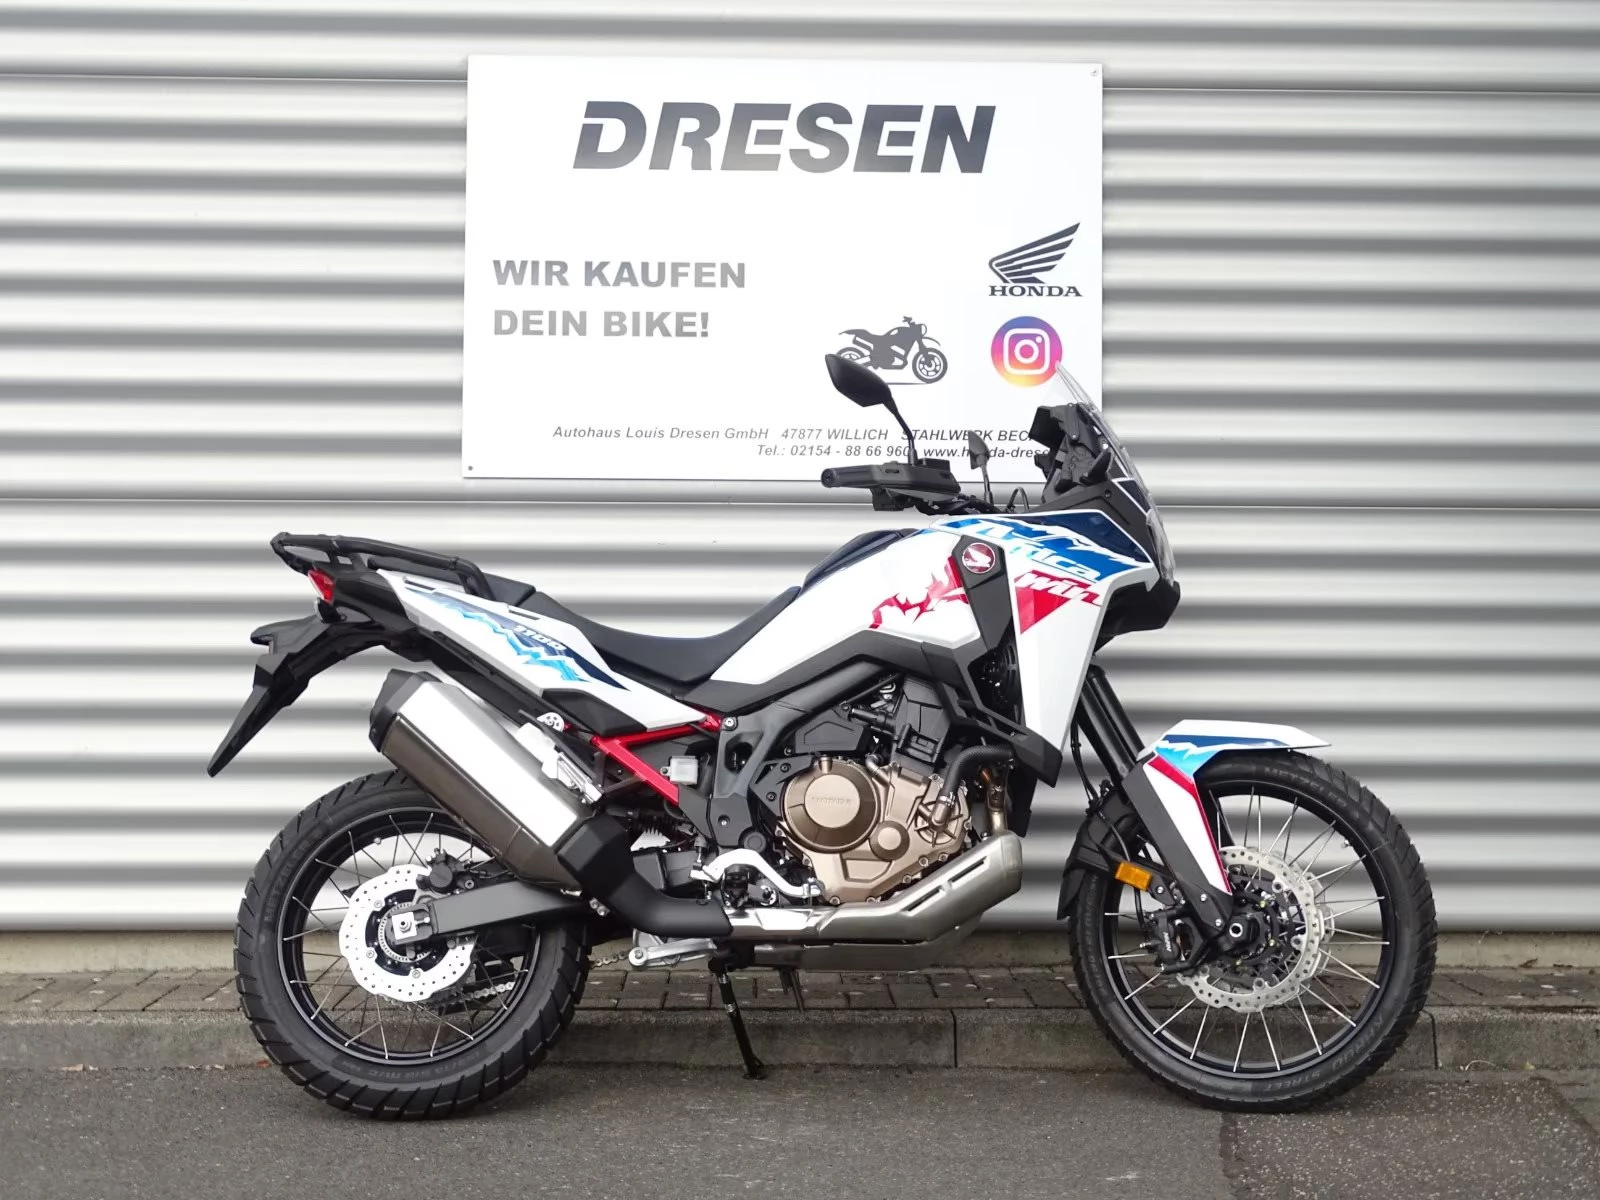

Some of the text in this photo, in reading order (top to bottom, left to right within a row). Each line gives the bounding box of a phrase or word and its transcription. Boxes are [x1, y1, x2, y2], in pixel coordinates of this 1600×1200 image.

[573, 101, 996, 174] DRESEN
[493, 260, 745, 288] WIR KAUFEN
[988, 285, 1083, 297] HONDA
[494, 310, 708, 337] DEIN BIKE!
[553, 426, 621, 438] Autohaus
[626, 427, 664, 439] Louis
[670, 427, 719, 439] Dresen
[725, 428, 768, 440] GmbH
[781, 429, 822, 440] 47877
[827, 429, 888, 440] WILLICH
[998, 430, 1032, 441] BEC
[757, 445, 785, 456] Tel.:
[790, 445, 831, 457] 02154
[845, 445, 861, 457] 88
[866, 446, 881, 457] 66
